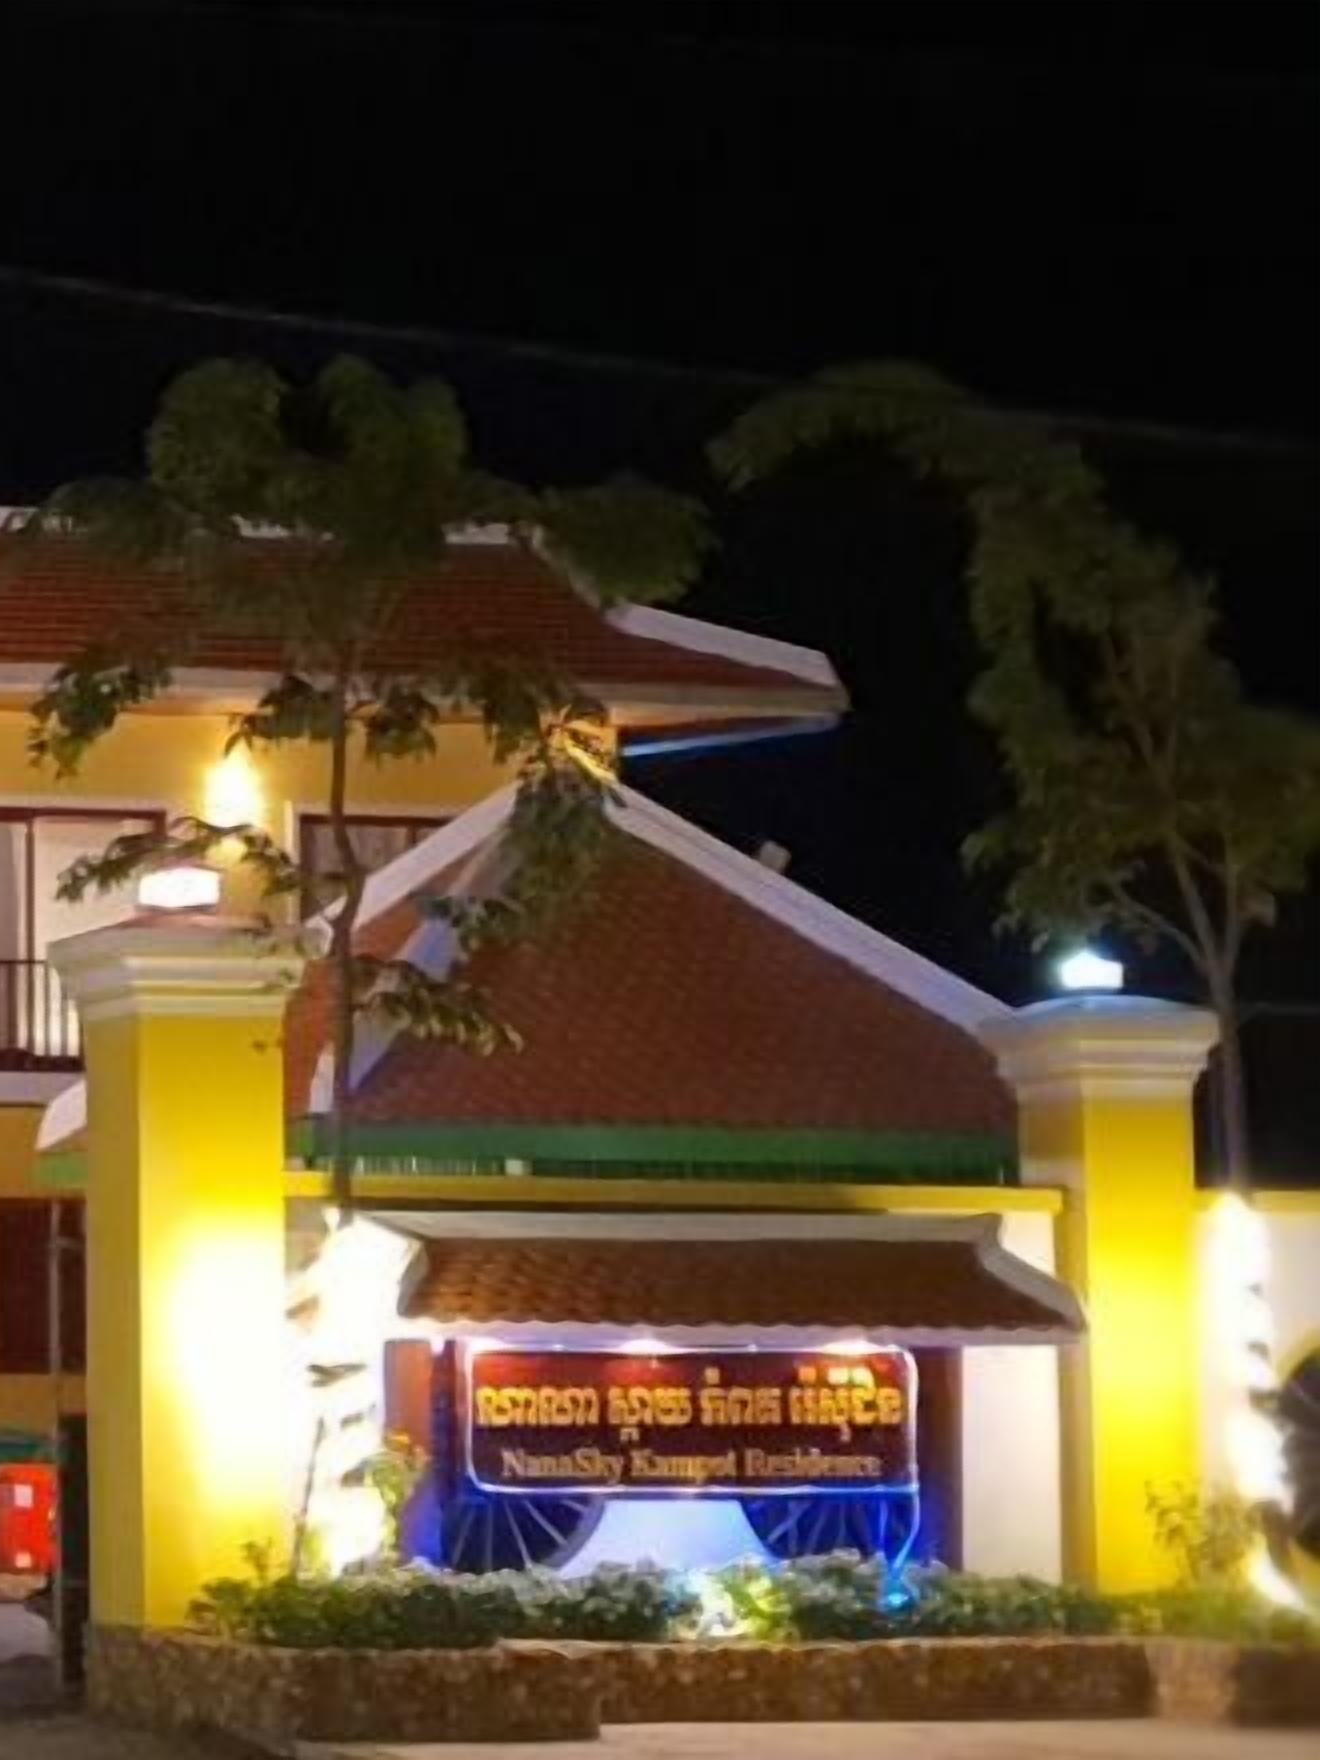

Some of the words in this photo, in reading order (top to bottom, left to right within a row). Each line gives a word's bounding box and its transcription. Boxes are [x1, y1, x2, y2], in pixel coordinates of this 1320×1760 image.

[502, 1448, 623, 1484] NanaSky
[631, 1448, 737, 1484] Kampot
[744, 1447, 882, 1477] Residence
